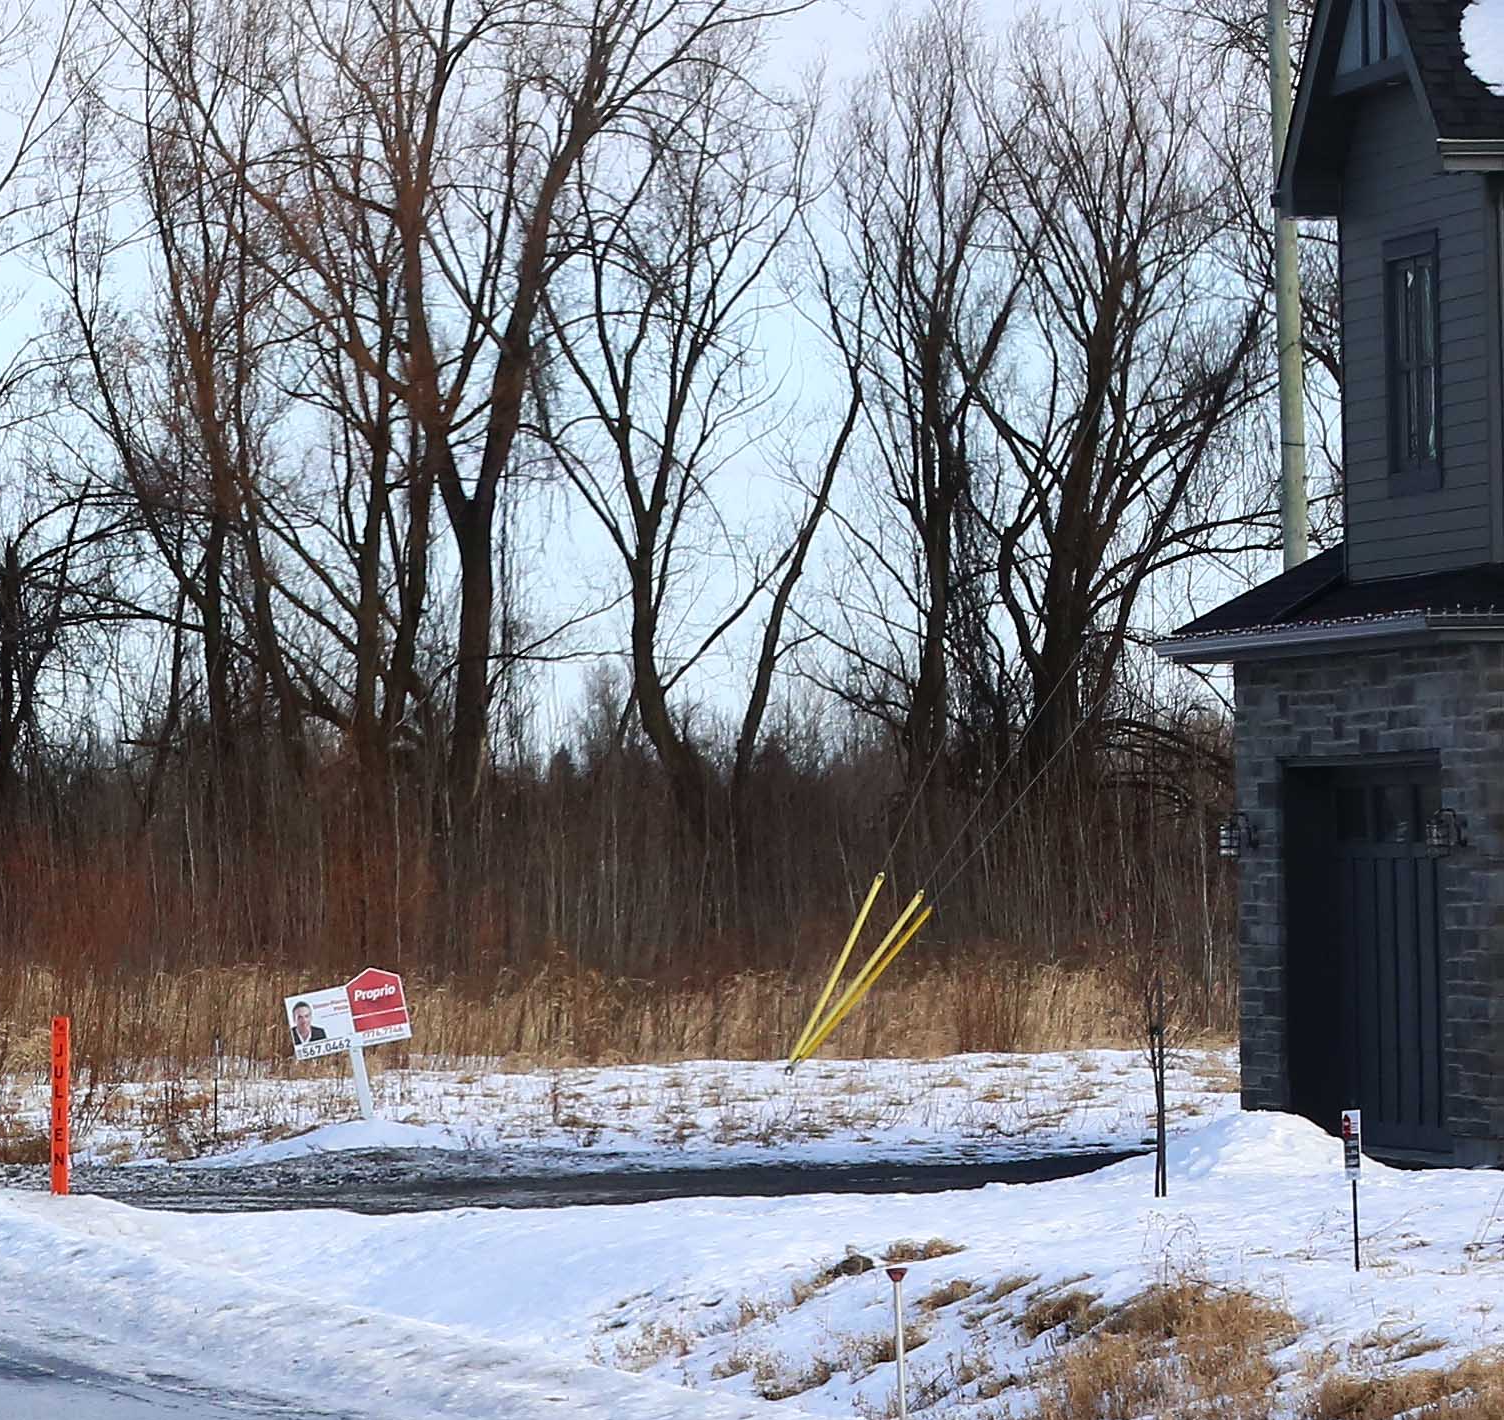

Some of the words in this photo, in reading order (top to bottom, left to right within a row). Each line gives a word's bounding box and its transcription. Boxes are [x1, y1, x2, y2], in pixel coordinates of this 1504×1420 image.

[354, 983, 396, 1002] Proprio
[302, 1038, 352, 1058] 567.0462
[54, 1044, 64, 1167] JULIEN
